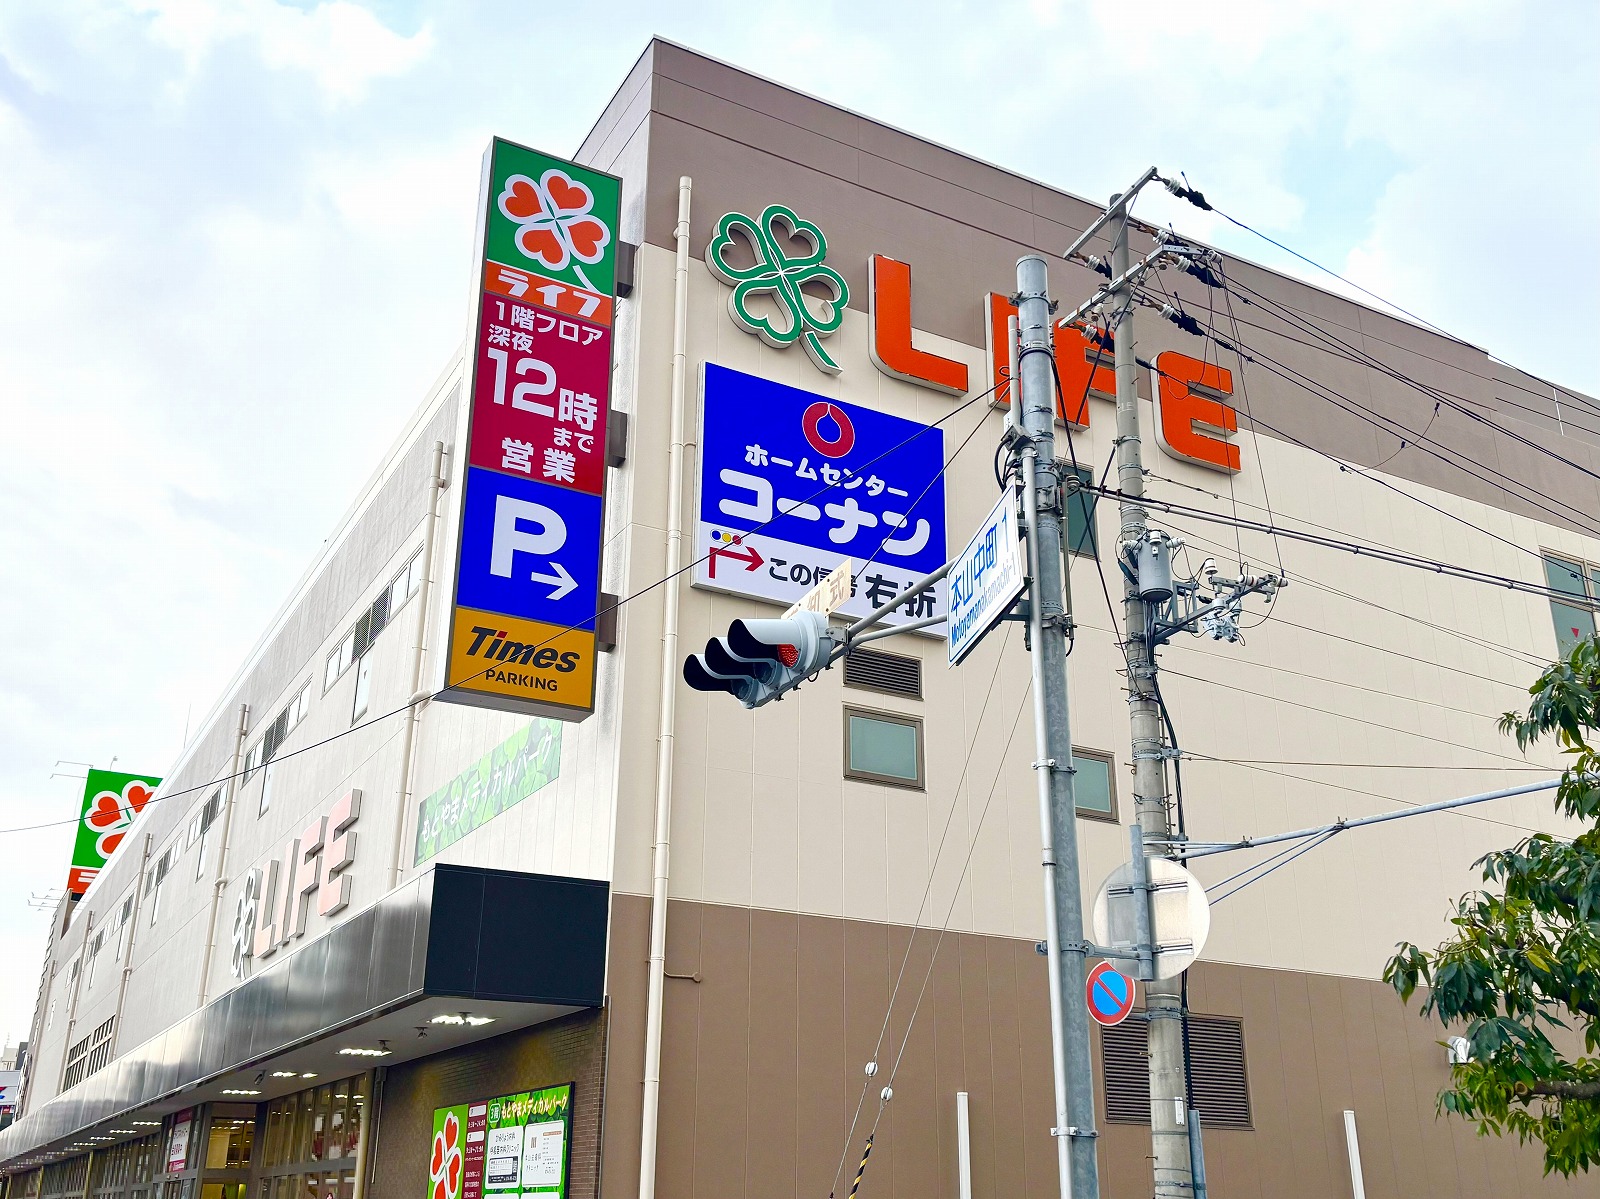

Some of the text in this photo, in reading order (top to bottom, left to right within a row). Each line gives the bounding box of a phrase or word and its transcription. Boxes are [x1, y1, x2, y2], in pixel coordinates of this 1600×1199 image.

[498, 268, 601, 318] ライフ
[487, 323, 534, 354] 深夜
[495, 300, 603, 347] 1階フロア
[867, 253, 1242, 475] LIFE
[501, 437, 577, 484] 営業
[553, 427, 595, 453] まで
[744, 444, 909, 498] ホームセンター
[718, 468, 931, 556] コーナン
[490, 494, 568, 579] P
[865, 573, 937, 619] 右折
[466, 625, 581, 673] Times
[485, 668, 559, 692] PARKING
[421, 731, 553, 843] もとやまメディカルパーク
[253, 788, 362, 959] LIFE
[502, 1093, 568, 1119] もとやまメディカルパーク
